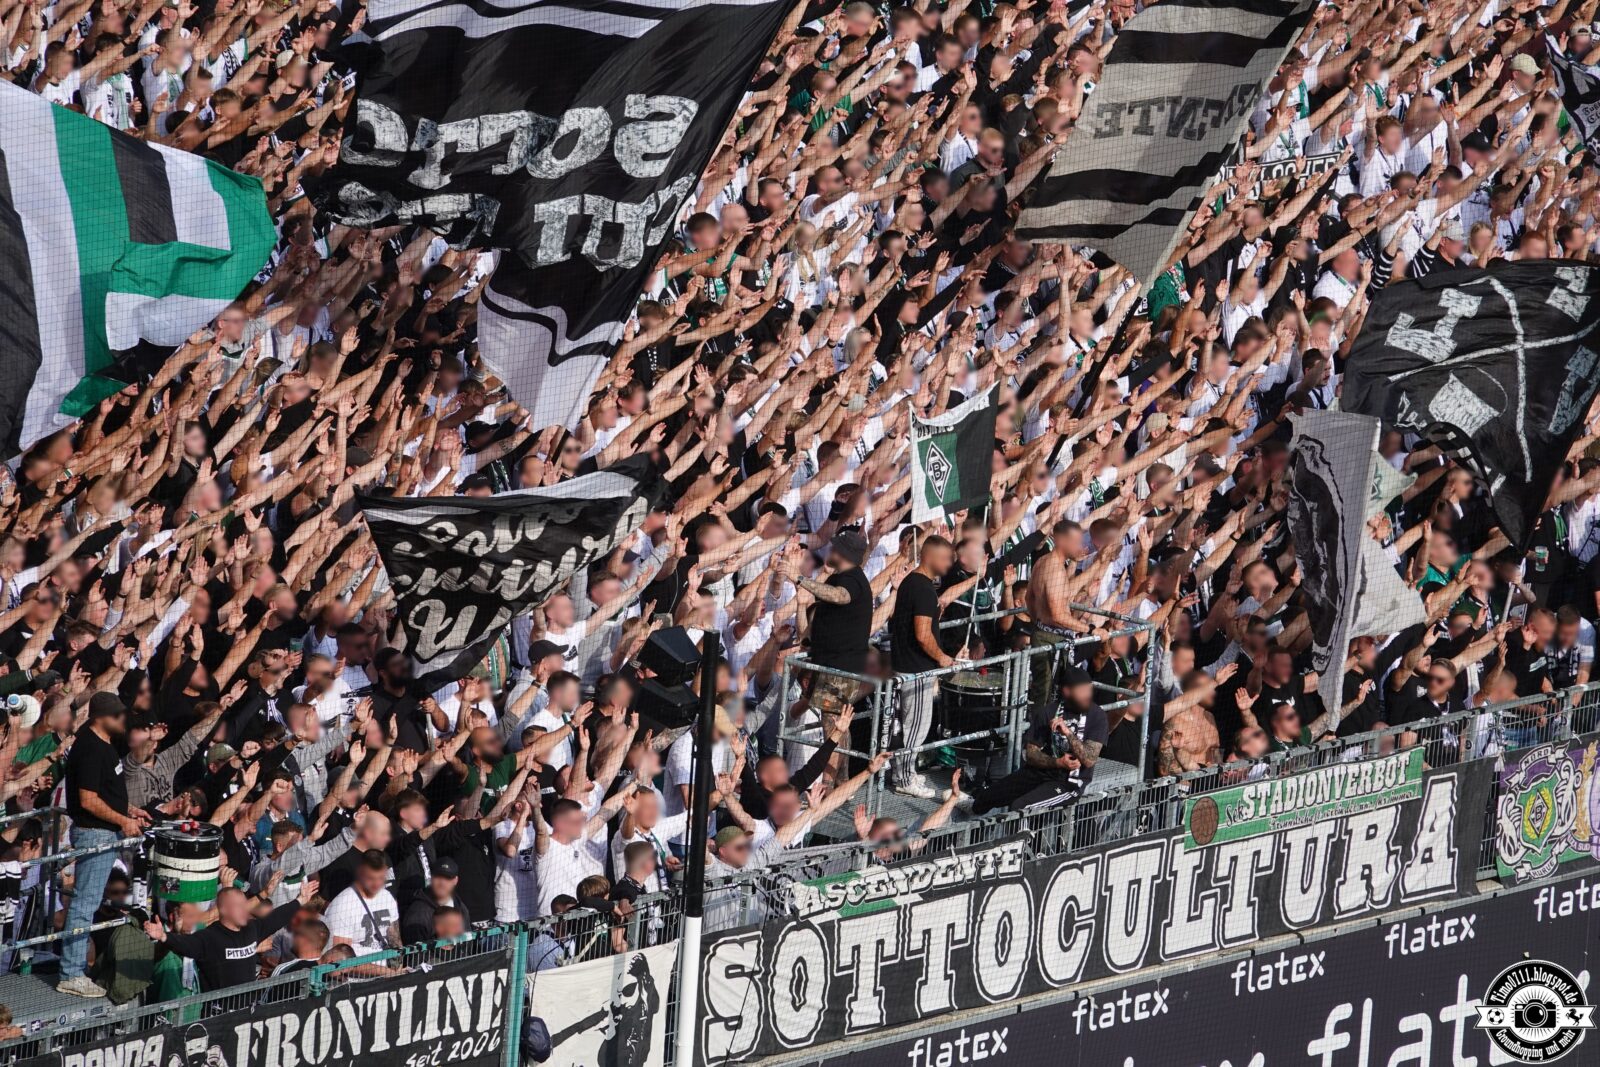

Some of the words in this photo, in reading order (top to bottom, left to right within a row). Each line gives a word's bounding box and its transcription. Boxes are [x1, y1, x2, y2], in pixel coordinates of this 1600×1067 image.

[1242, 752, 1410, 822] STADIONVERBOT
[701, 772, 1459, 1067] SOTTOCULTURA
[789, 841, 1025, 921] ASCENDENTE
[234, 968, 509, 1067] FRONTLINE
[447, 1031, 501, 1062] 2006
